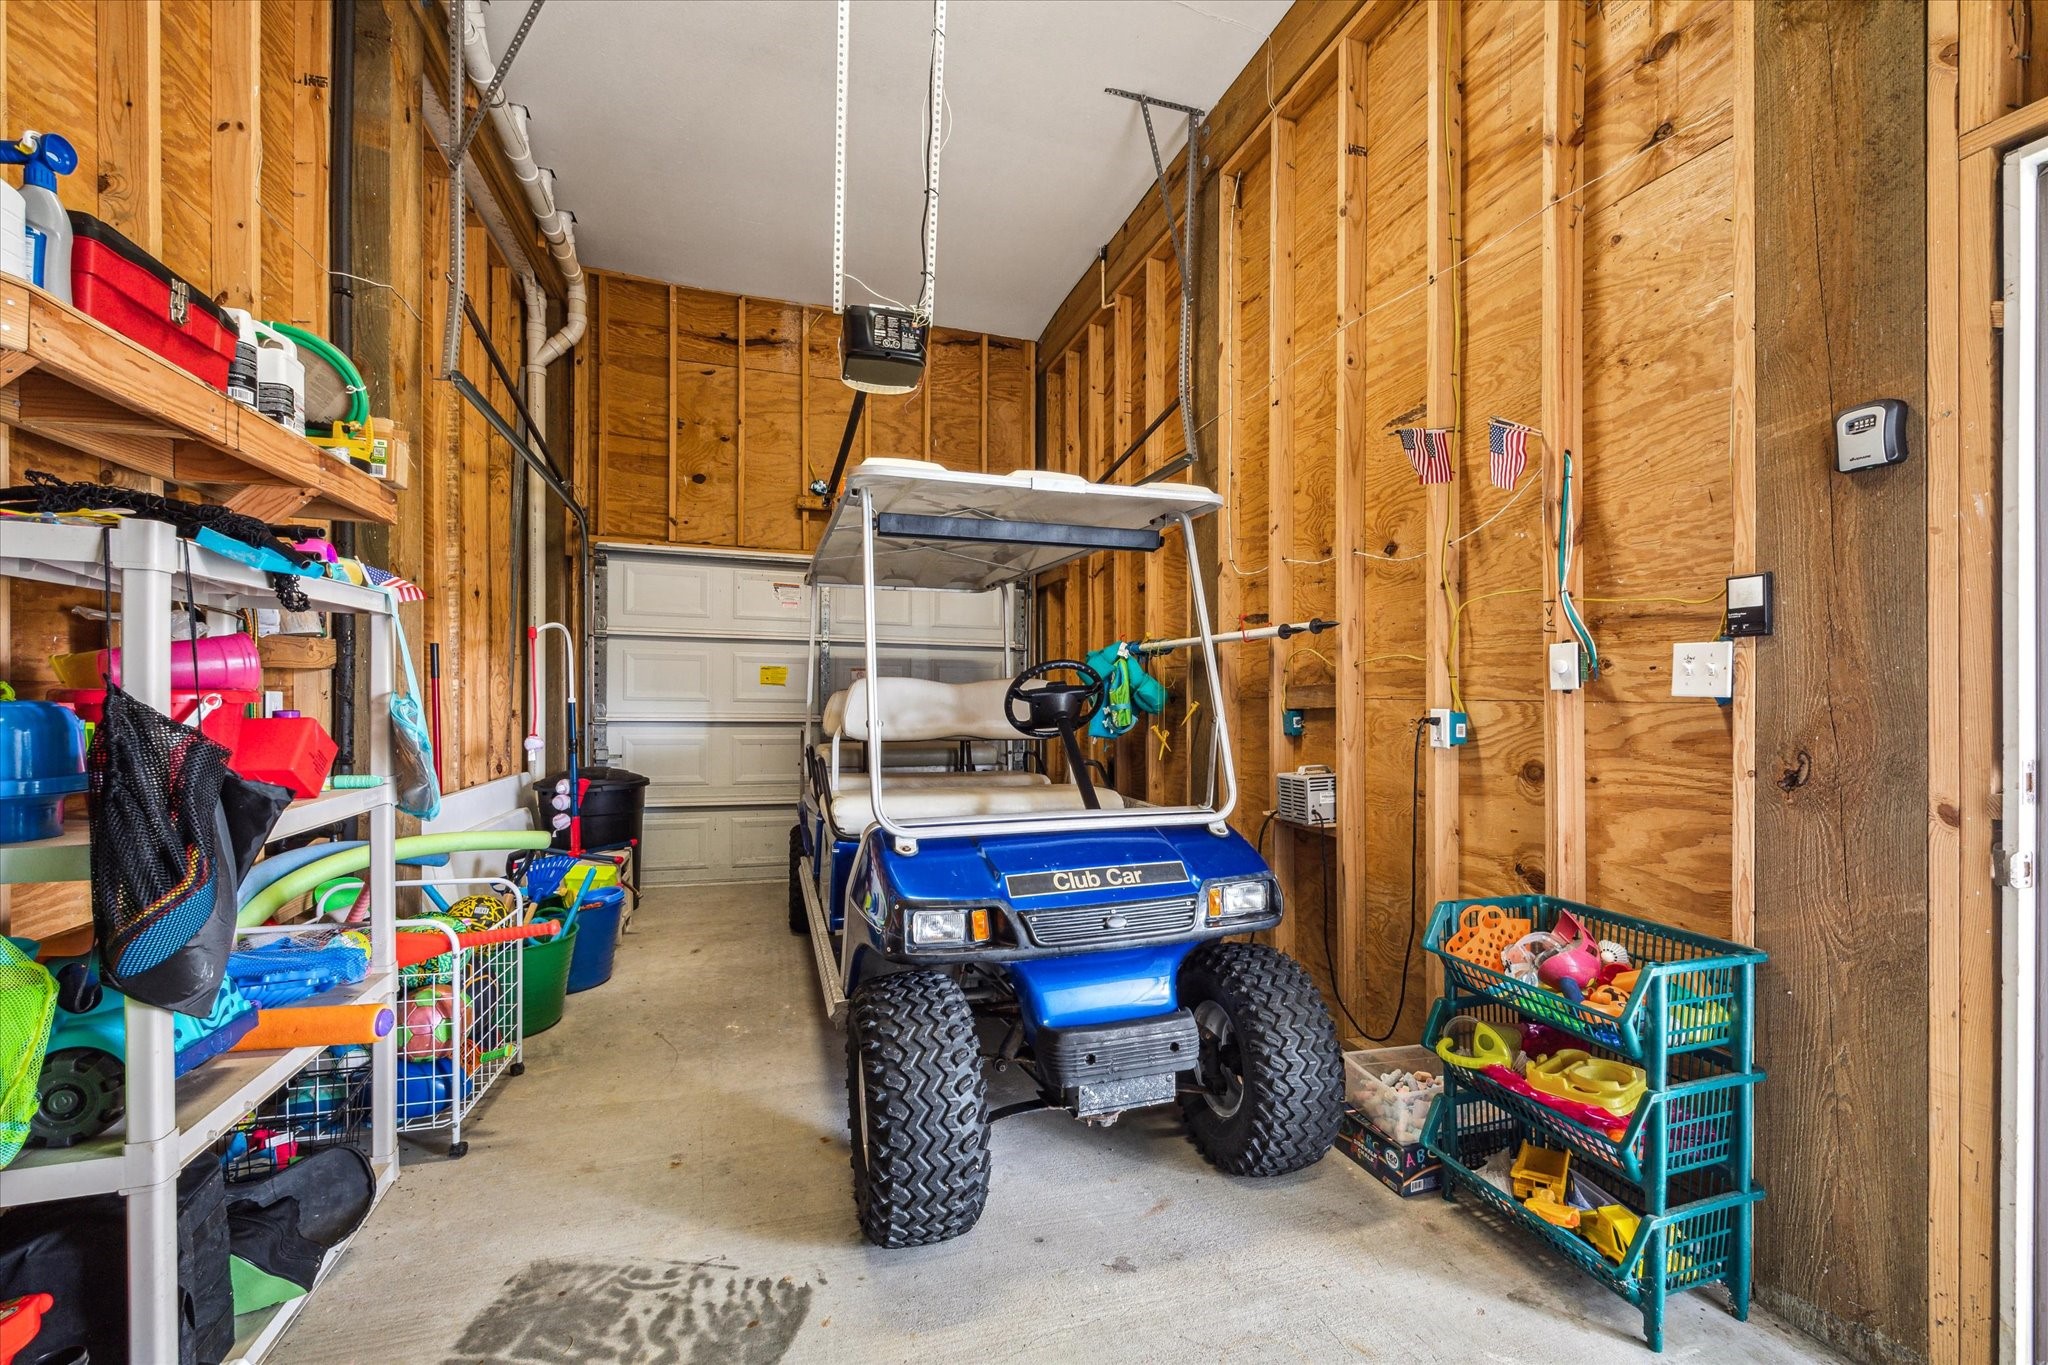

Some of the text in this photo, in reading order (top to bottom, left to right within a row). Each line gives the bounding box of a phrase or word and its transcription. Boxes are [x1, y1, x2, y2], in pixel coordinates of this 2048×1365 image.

[1053, 868, 1142, 891] Club Car
[1353, 1138, 1378, 1159] SIDEWALK
[1357, 1148, 1375, 1163] CHALK
[1386, 1152, 1398, 1164] 160
